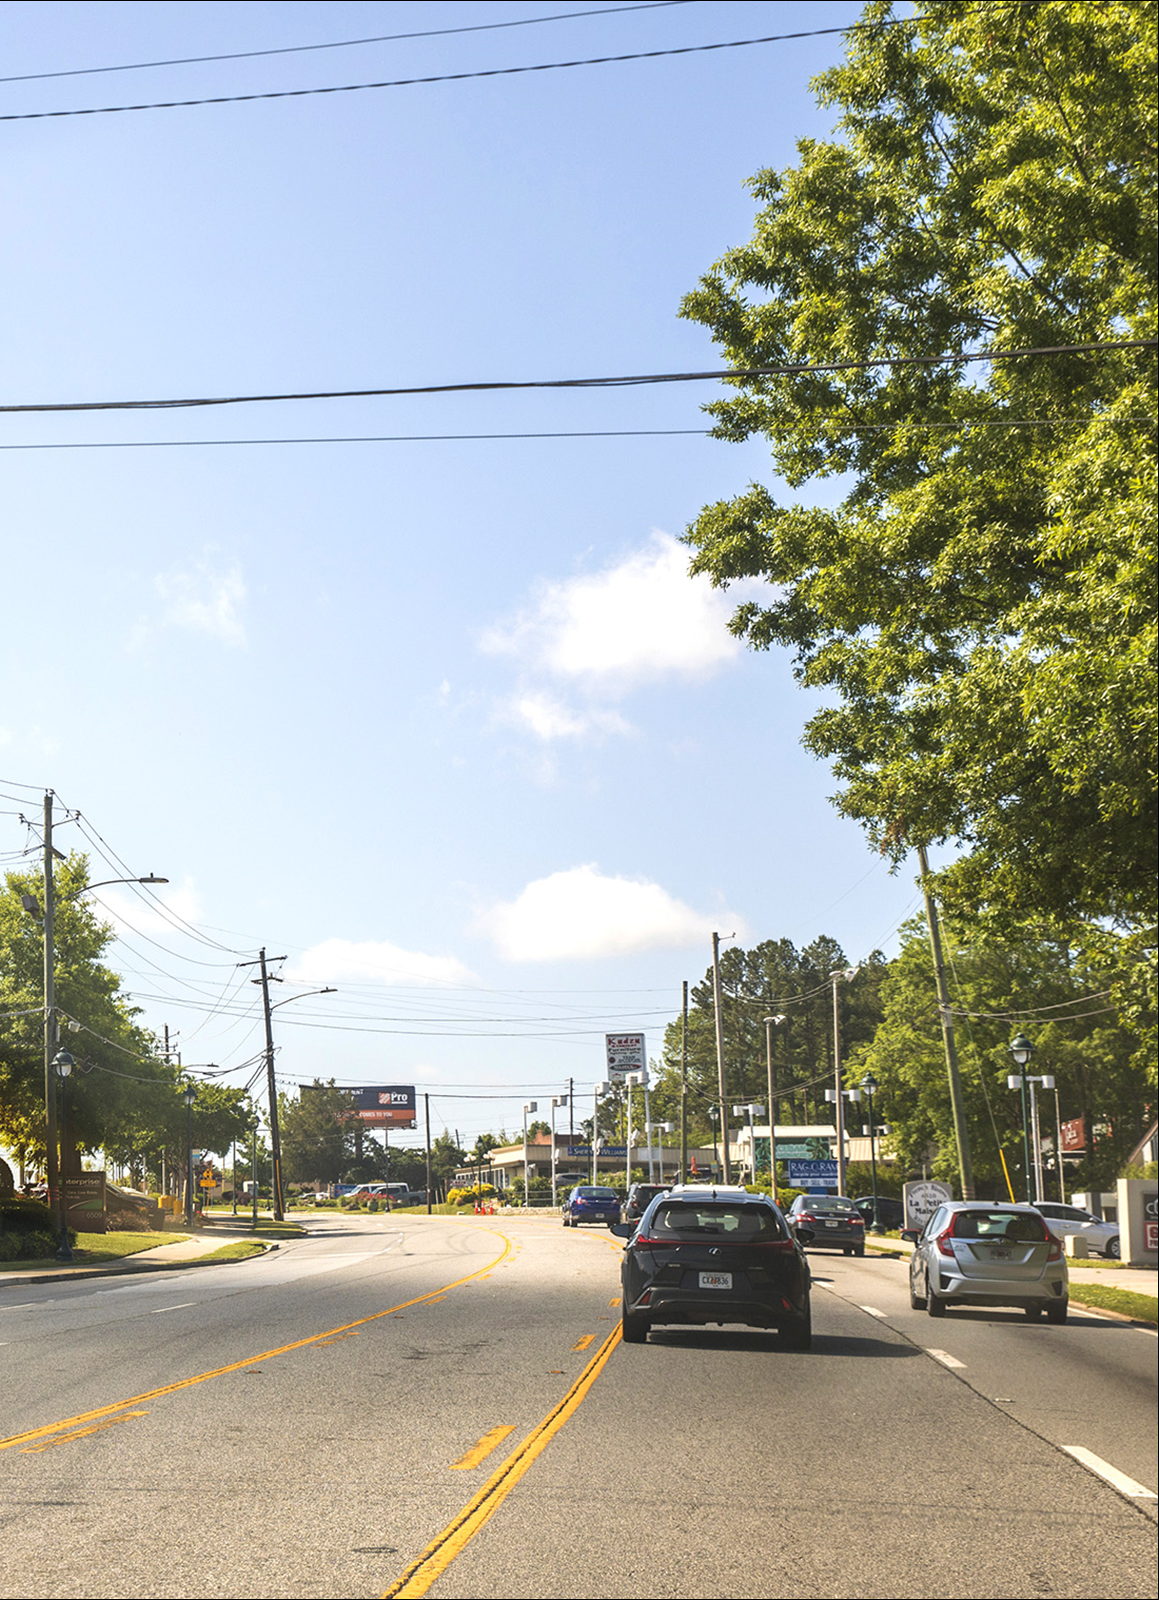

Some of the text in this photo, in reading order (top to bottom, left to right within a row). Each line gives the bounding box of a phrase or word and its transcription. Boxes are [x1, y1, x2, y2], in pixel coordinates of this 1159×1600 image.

[608, 1037, 640, 1045] Kudzu
[391, 1093, 408, 1101] Pro
[791, 1162, 838, 1172] RAG-O-RAM
[909, 1199, 920, 1207] La
